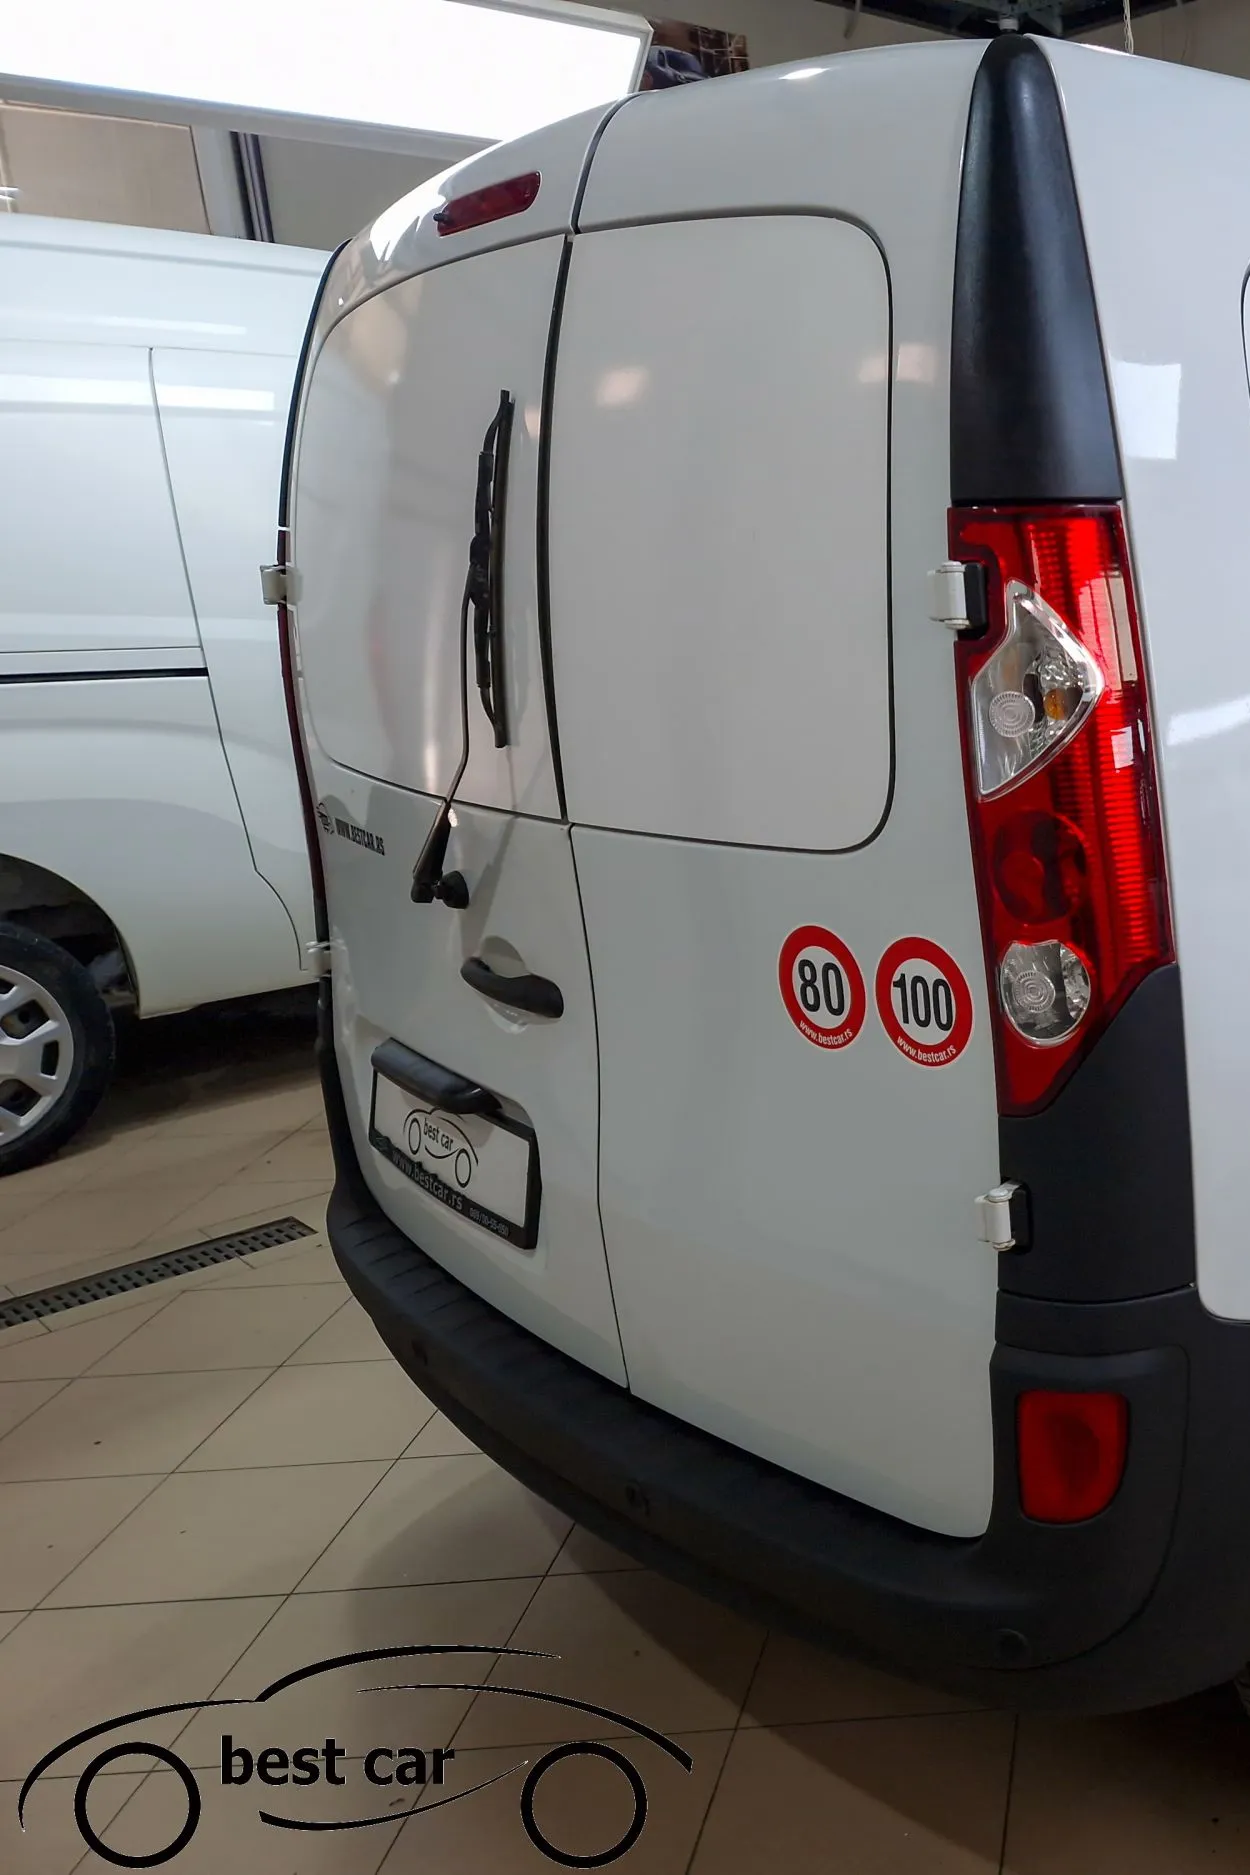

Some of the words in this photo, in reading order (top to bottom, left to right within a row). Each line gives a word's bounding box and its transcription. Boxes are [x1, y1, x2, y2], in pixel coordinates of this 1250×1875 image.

[797, 958, 845, 1016] 80
[892, 972, 954, 1032] 100
[798, 1019, 853, 1046] www.bestcar.rs
[896, 1035, 956, 1064] www.bestcar.rs
[423, 1118, 439, 1143] best
[440, 1133, 454, 1150] car
